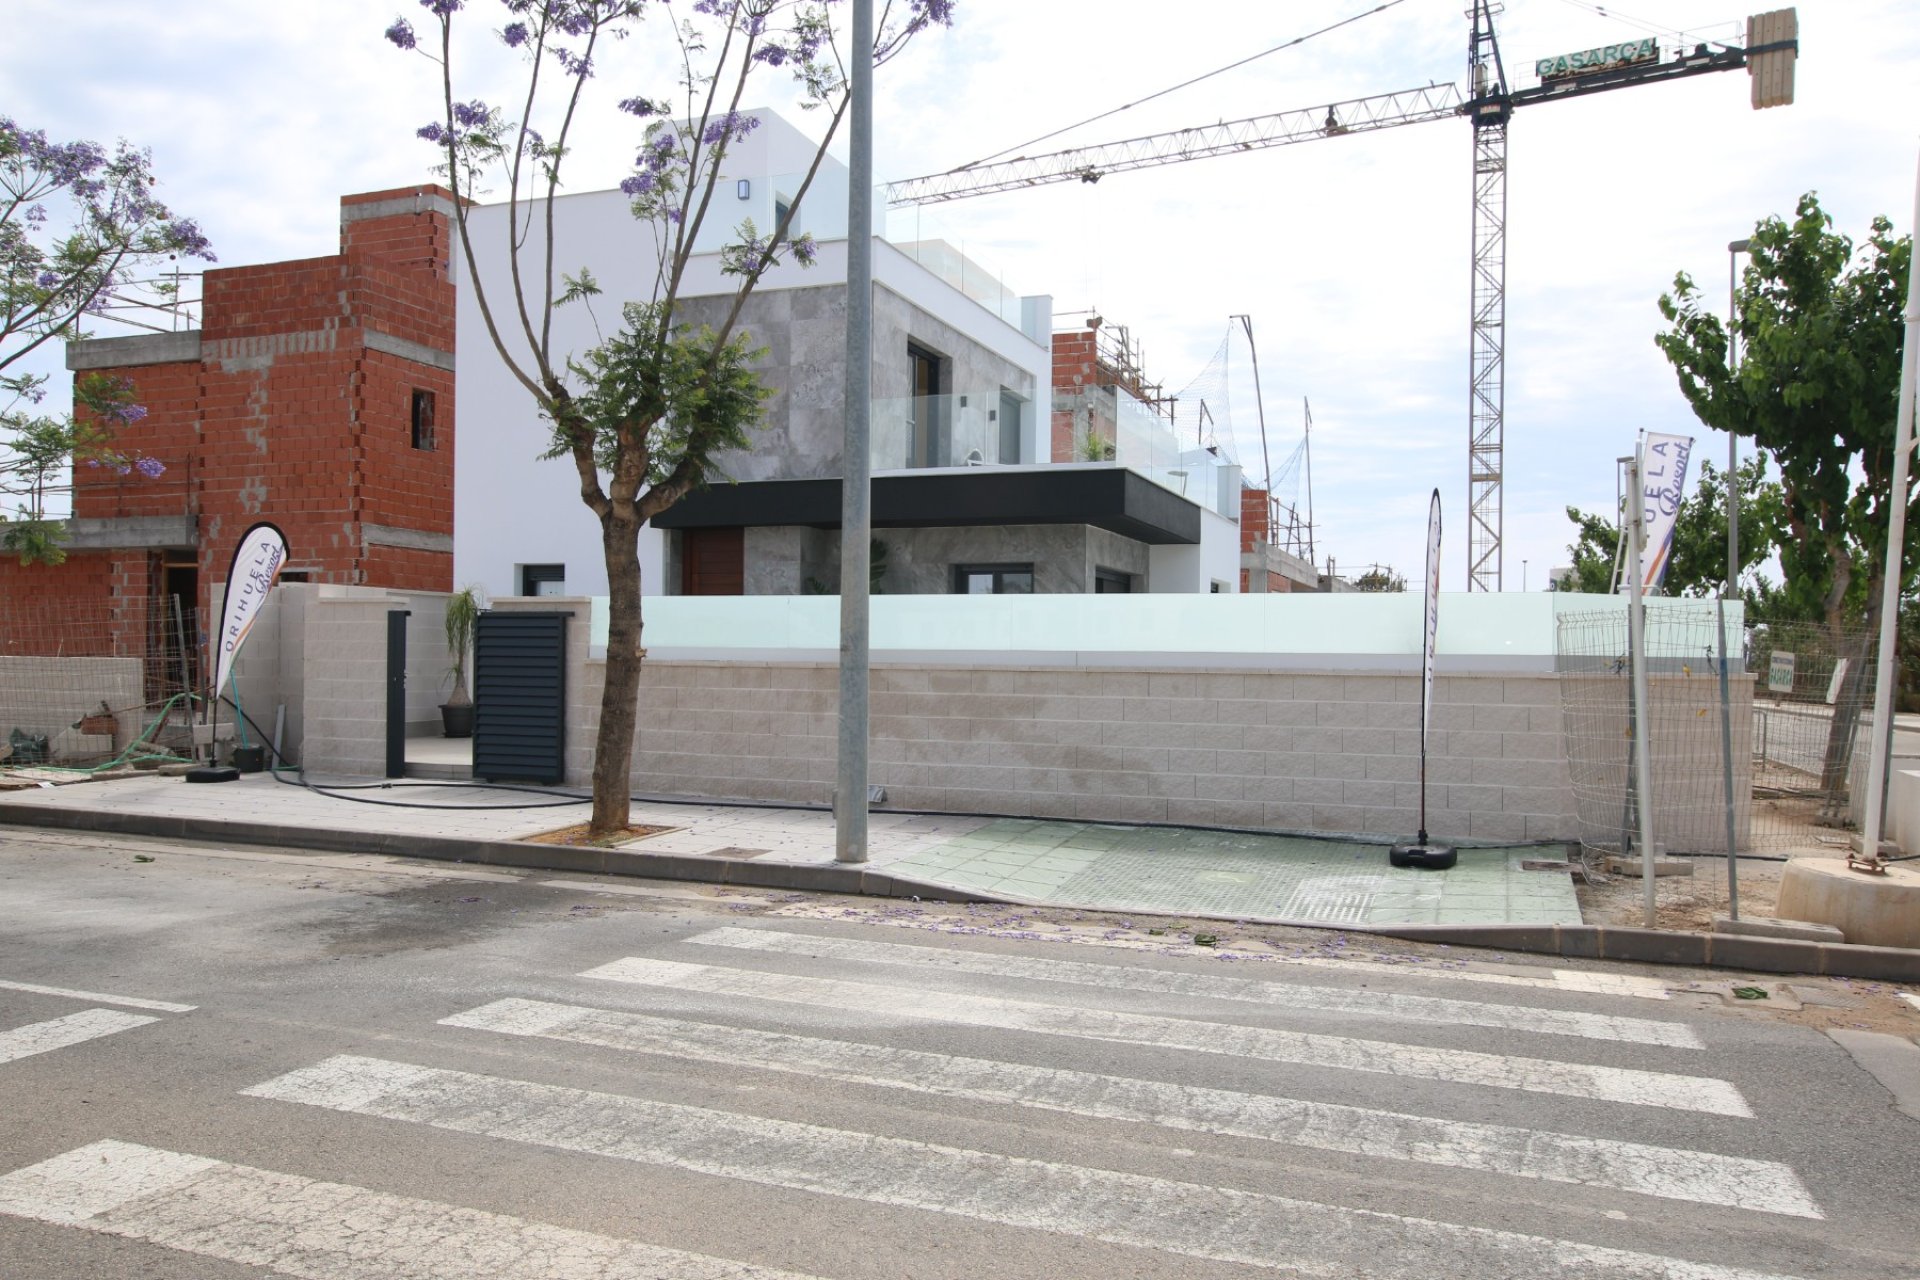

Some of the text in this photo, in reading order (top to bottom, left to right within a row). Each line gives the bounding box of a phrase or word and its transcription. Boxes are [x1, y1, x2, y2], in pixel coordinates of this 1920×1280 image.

[1538, 39, 1652, 75] GASARCA
[1659, 441, 1689, 517] Resort
[225, 542, 270, 652] ORIHUELA
[255, 545, 281, 594] Resort
